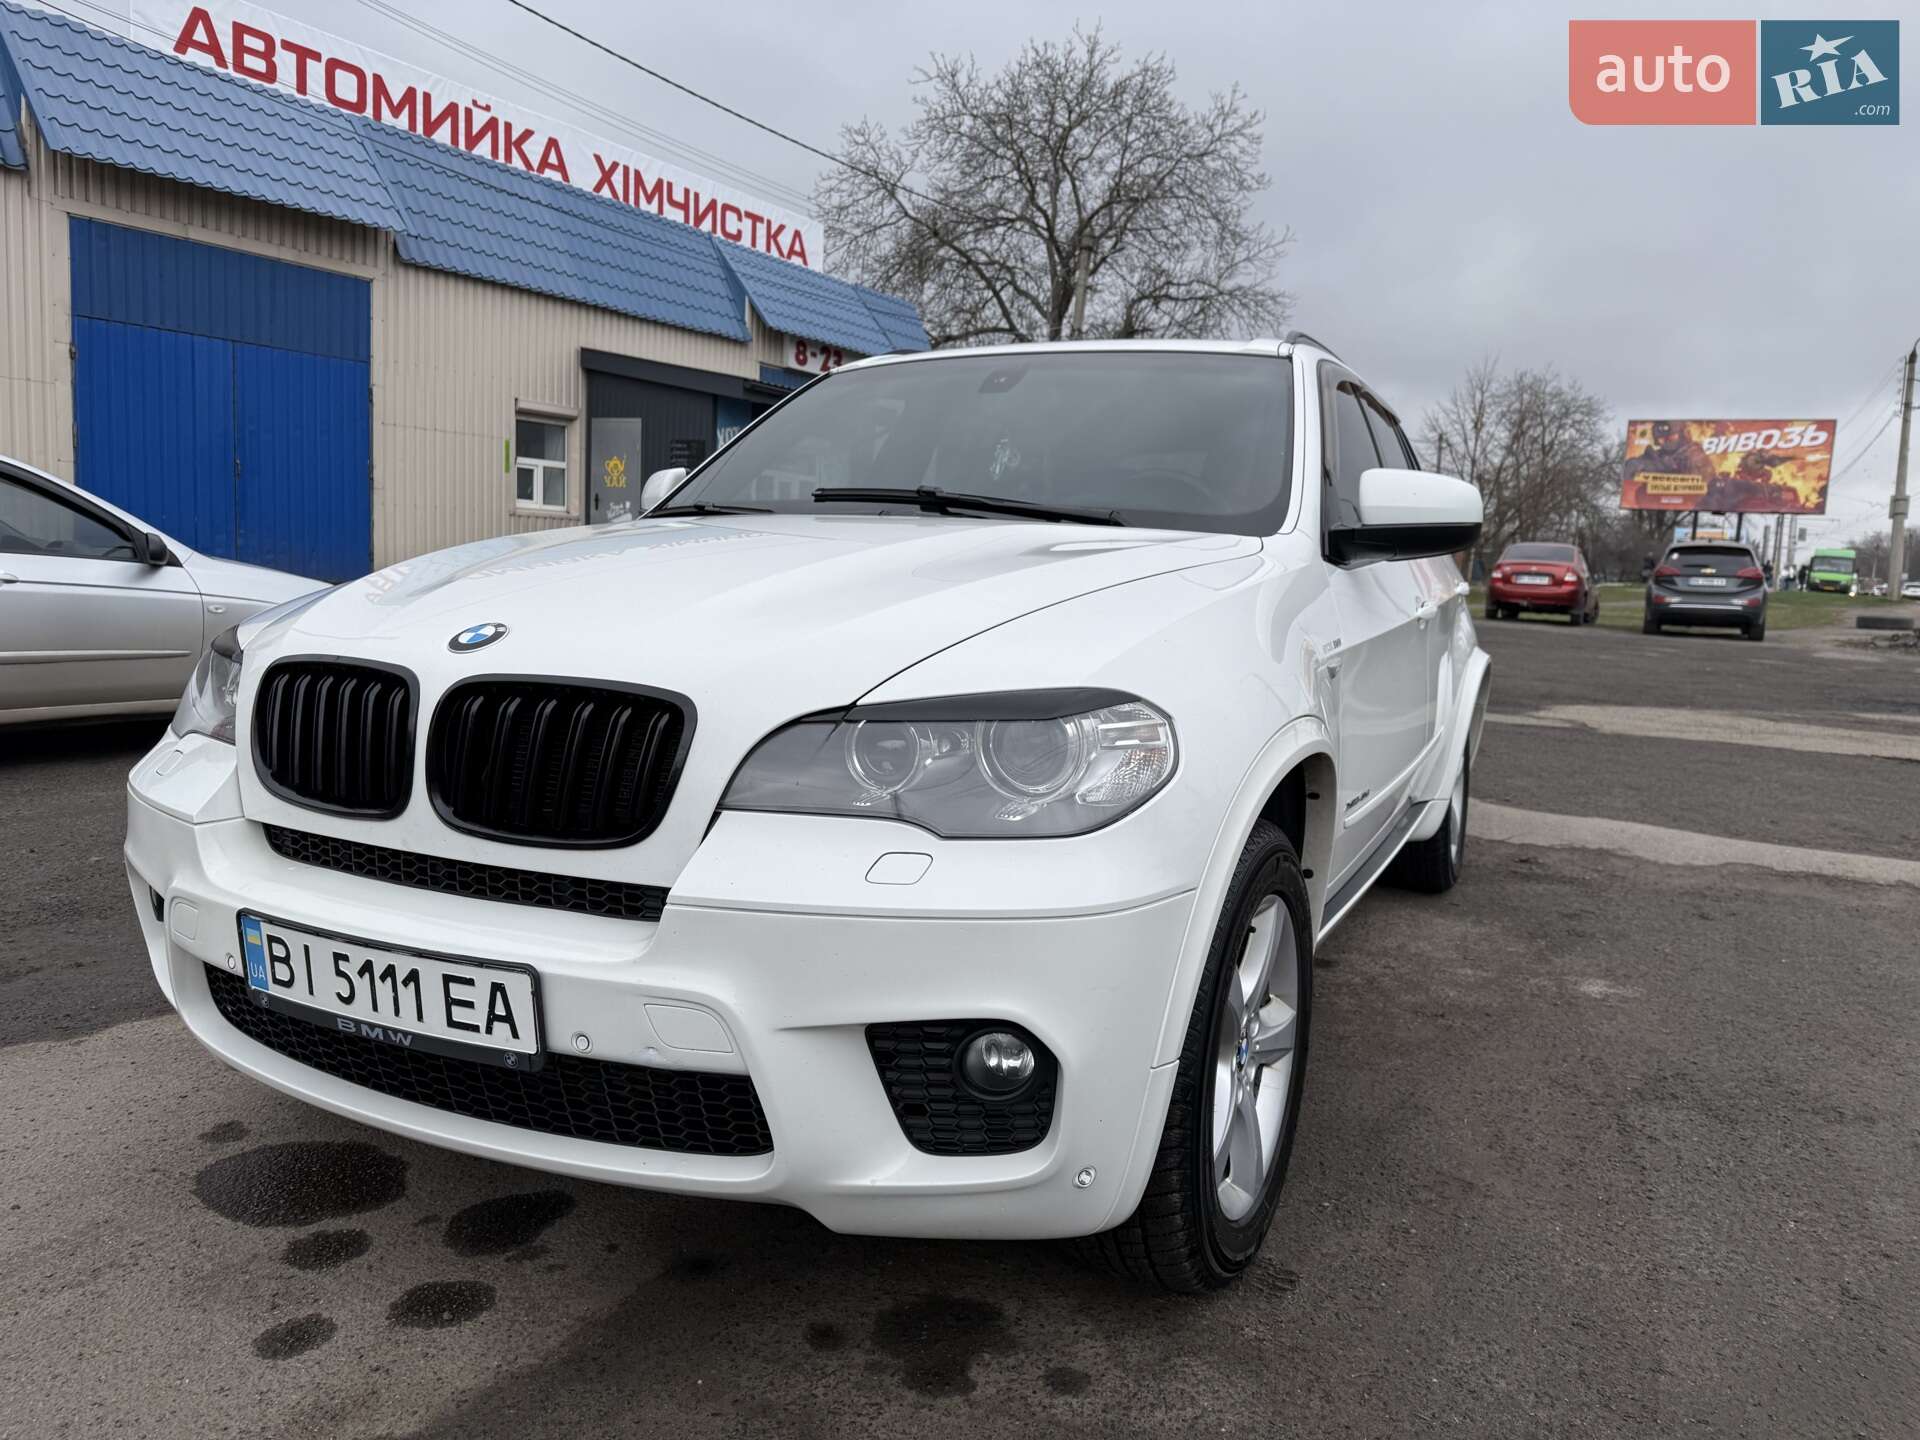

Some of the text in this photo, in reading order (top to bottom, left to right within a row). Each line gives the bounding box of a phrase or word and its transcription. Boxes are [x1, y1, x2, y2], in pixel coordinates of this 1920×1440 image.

[174, 7, 808, 266] АВТОМИЙКА ХІМЧИСТКА
[794, 340, 843, 373] 8-23
[1702, 424, 1829, 455] ВИВОЗЬ
[251, 966, 266, 981] UA
[266, 933, 521, 1041] BI 5111 EA
[336, 1016, 413, 1048] BMW
